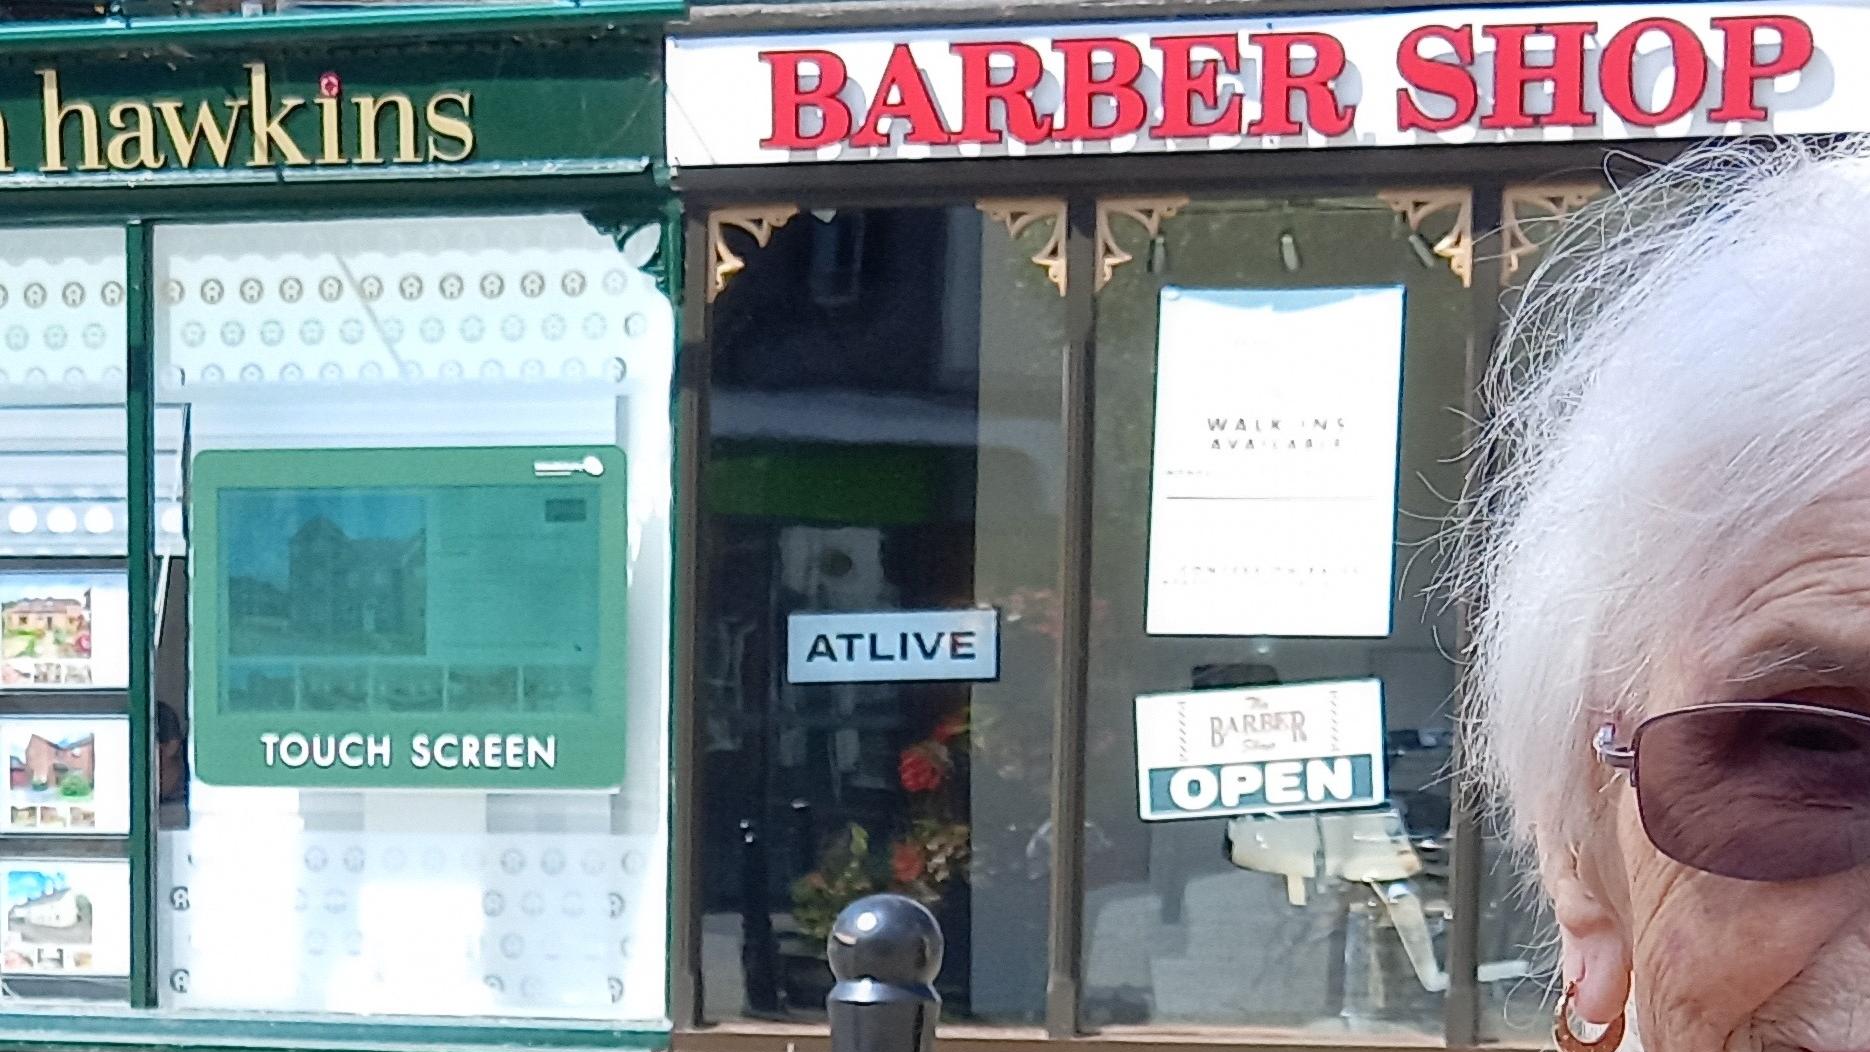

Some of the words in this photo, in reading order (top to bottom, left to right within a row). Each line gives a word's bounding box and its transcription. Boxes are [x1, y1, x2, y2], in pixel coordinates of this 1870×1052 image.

[757, 33, 1356, 150] BARBER
[1396, 15, 1815, 131] SHOP
[35, 62, 475, 172] hawkins
[1207, 417, 1281, 432] WALK
[1210, 438, 1341, 450] AVALABE
[806, 632, 977, 662] ATLIVE
[1209, 710, 1308, 748] BARBER
[260, 733, 393, 769] TOUCH
[410, 734, 557, 769] SCREEN
[1169, 757, 1353, 812] OPEN
